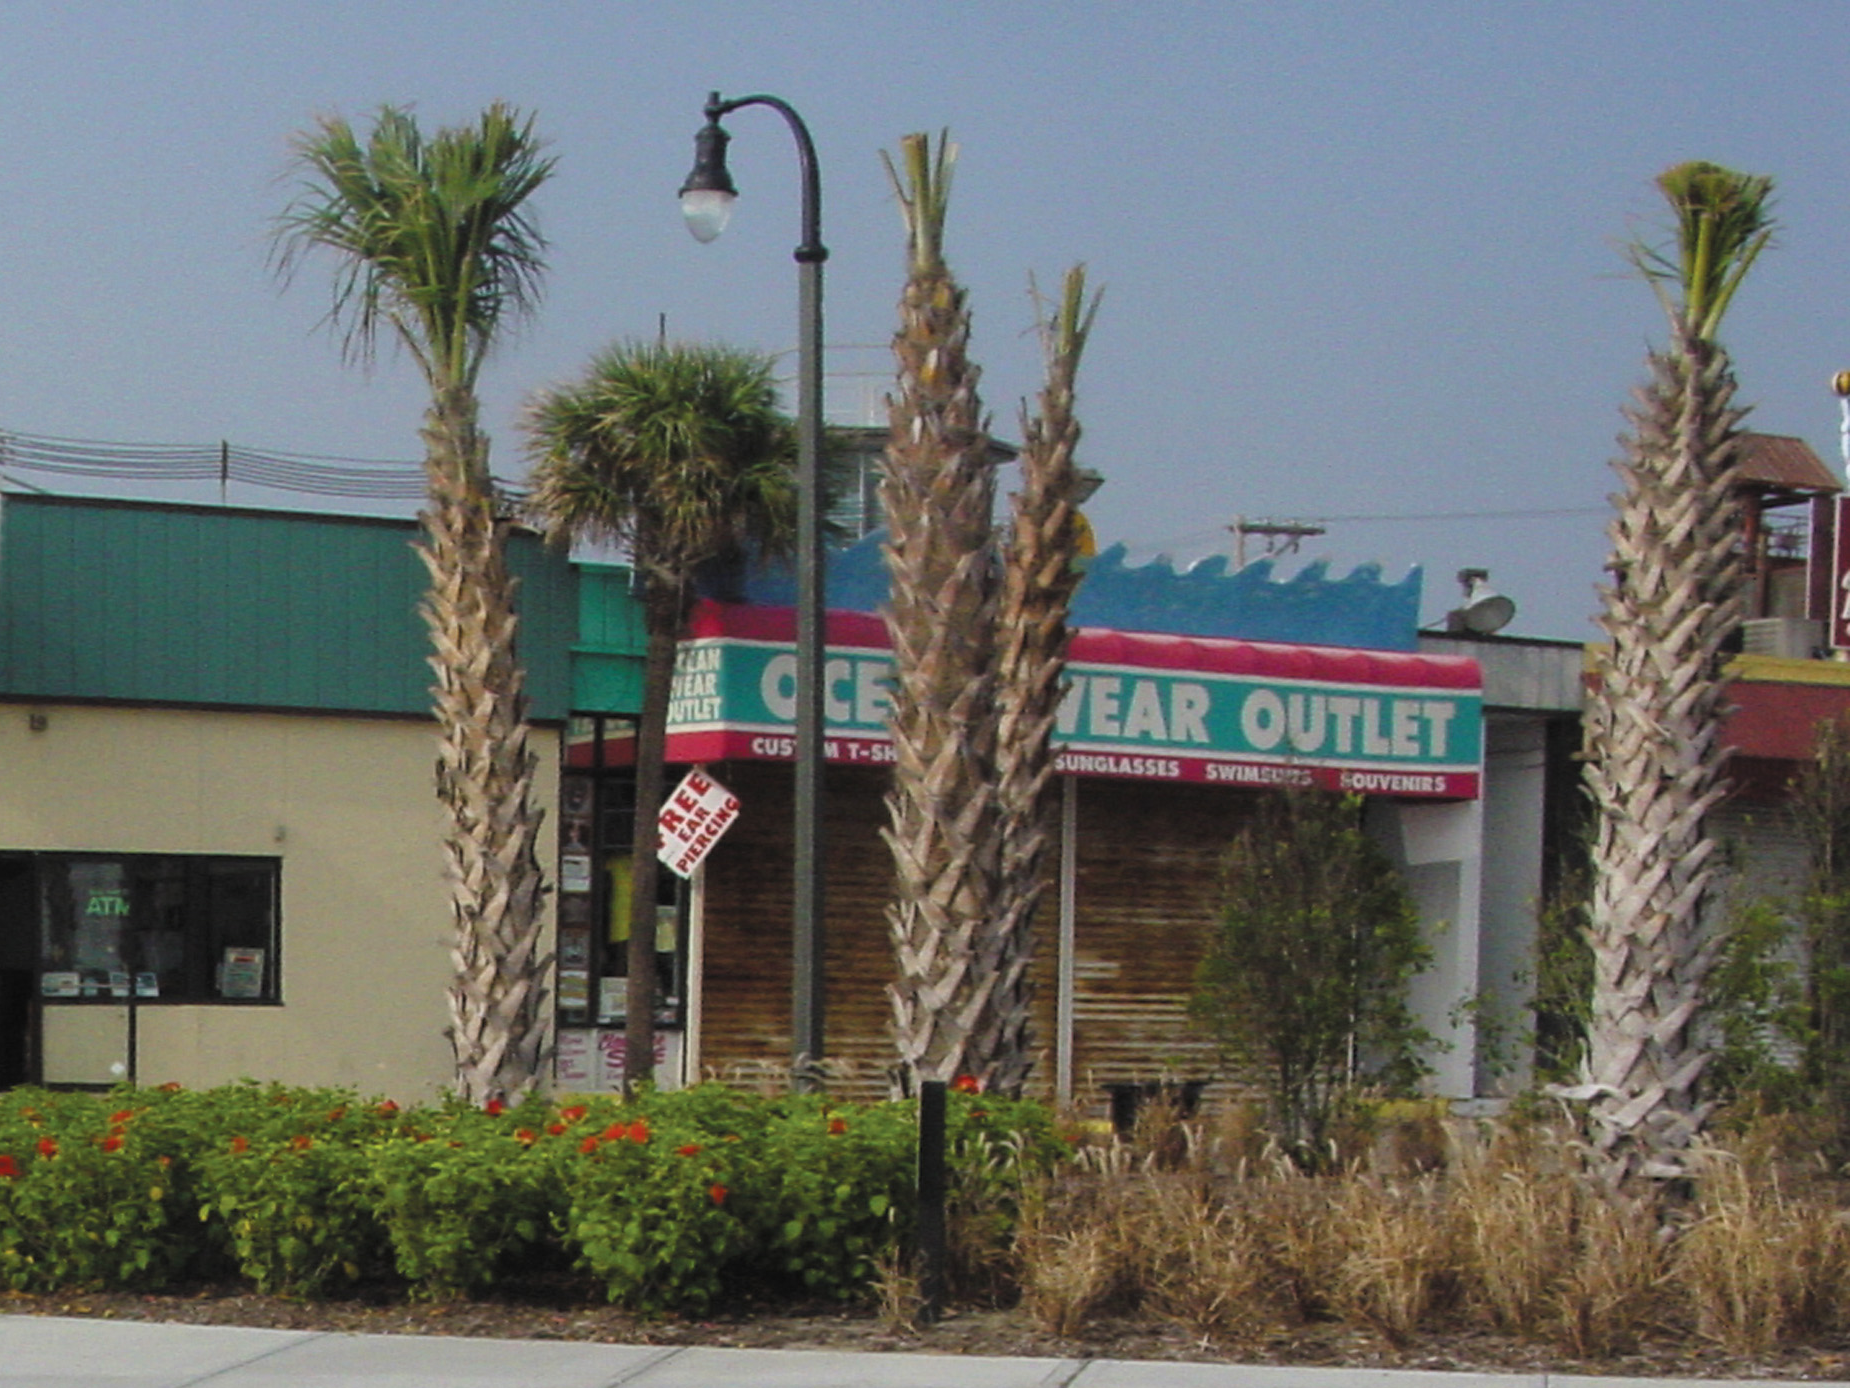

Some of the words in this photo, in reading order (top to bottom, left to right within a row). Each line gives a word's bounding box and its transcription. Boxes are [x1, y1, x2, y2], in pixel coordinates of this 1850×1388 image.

[1241, 689, 1457, 757] OUTLET
[1055, 754, 1180, 777] SUNGLASSES
[675, 797, 743, 874] PIERCING
[677, 806, 711, 843] EAR
